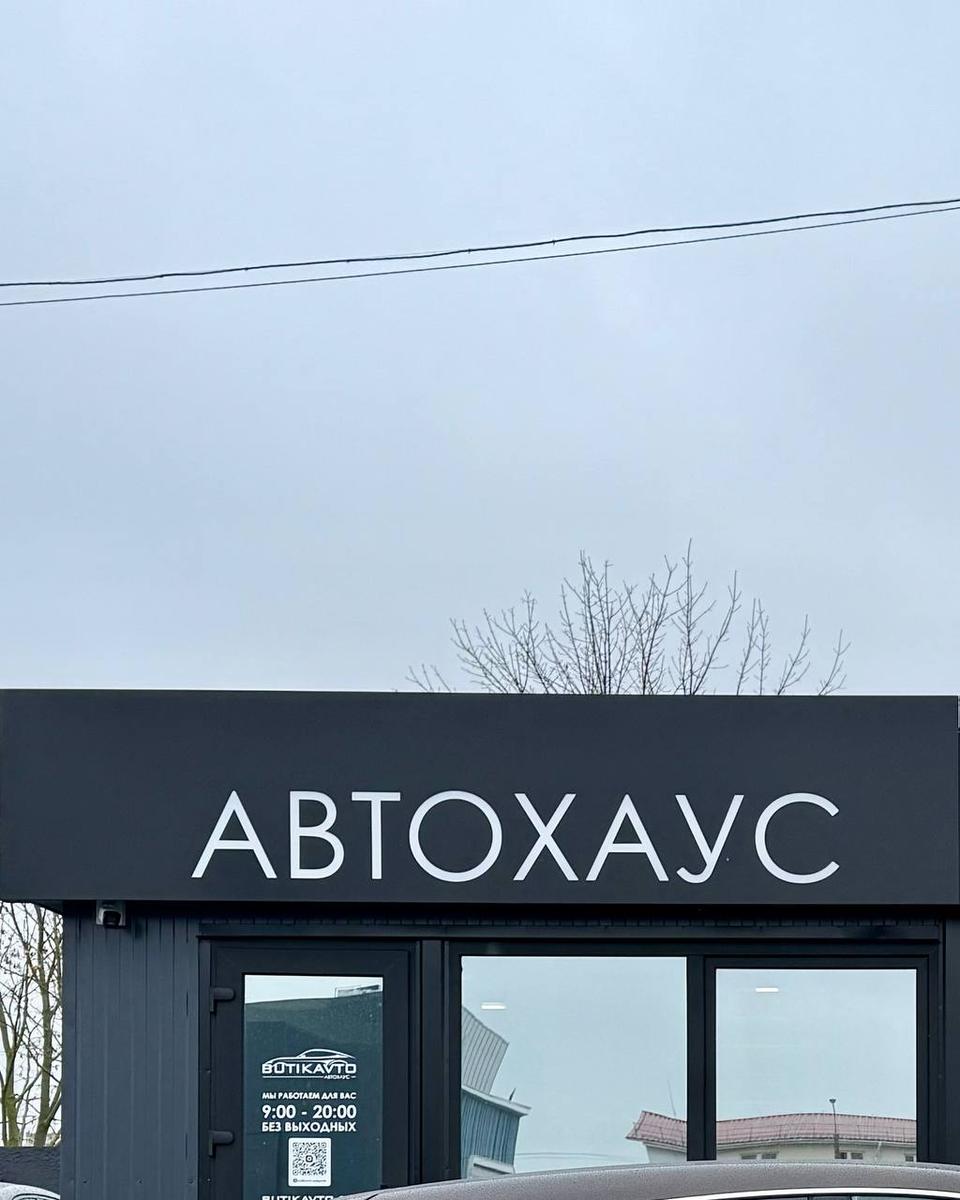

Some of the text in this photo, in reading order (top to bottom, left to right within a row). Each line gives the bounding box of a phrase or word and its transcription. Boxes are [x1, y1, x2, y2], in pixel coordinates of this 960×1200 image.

[191, 790, 840, 884] АВТОХАУС
[262, 1063, 357, 1074] BUTIKAVTO
[262, 1092, 357, 1100] МЫ РАБОТАЕМ ДЛЯ ВАС
[262, 1104, 297, 1119] 9:00
[312, 1104, 357, 1119] 20:00
[261, 1121, 357, 1133] БЕЗ ВЫХОДНЫХ
